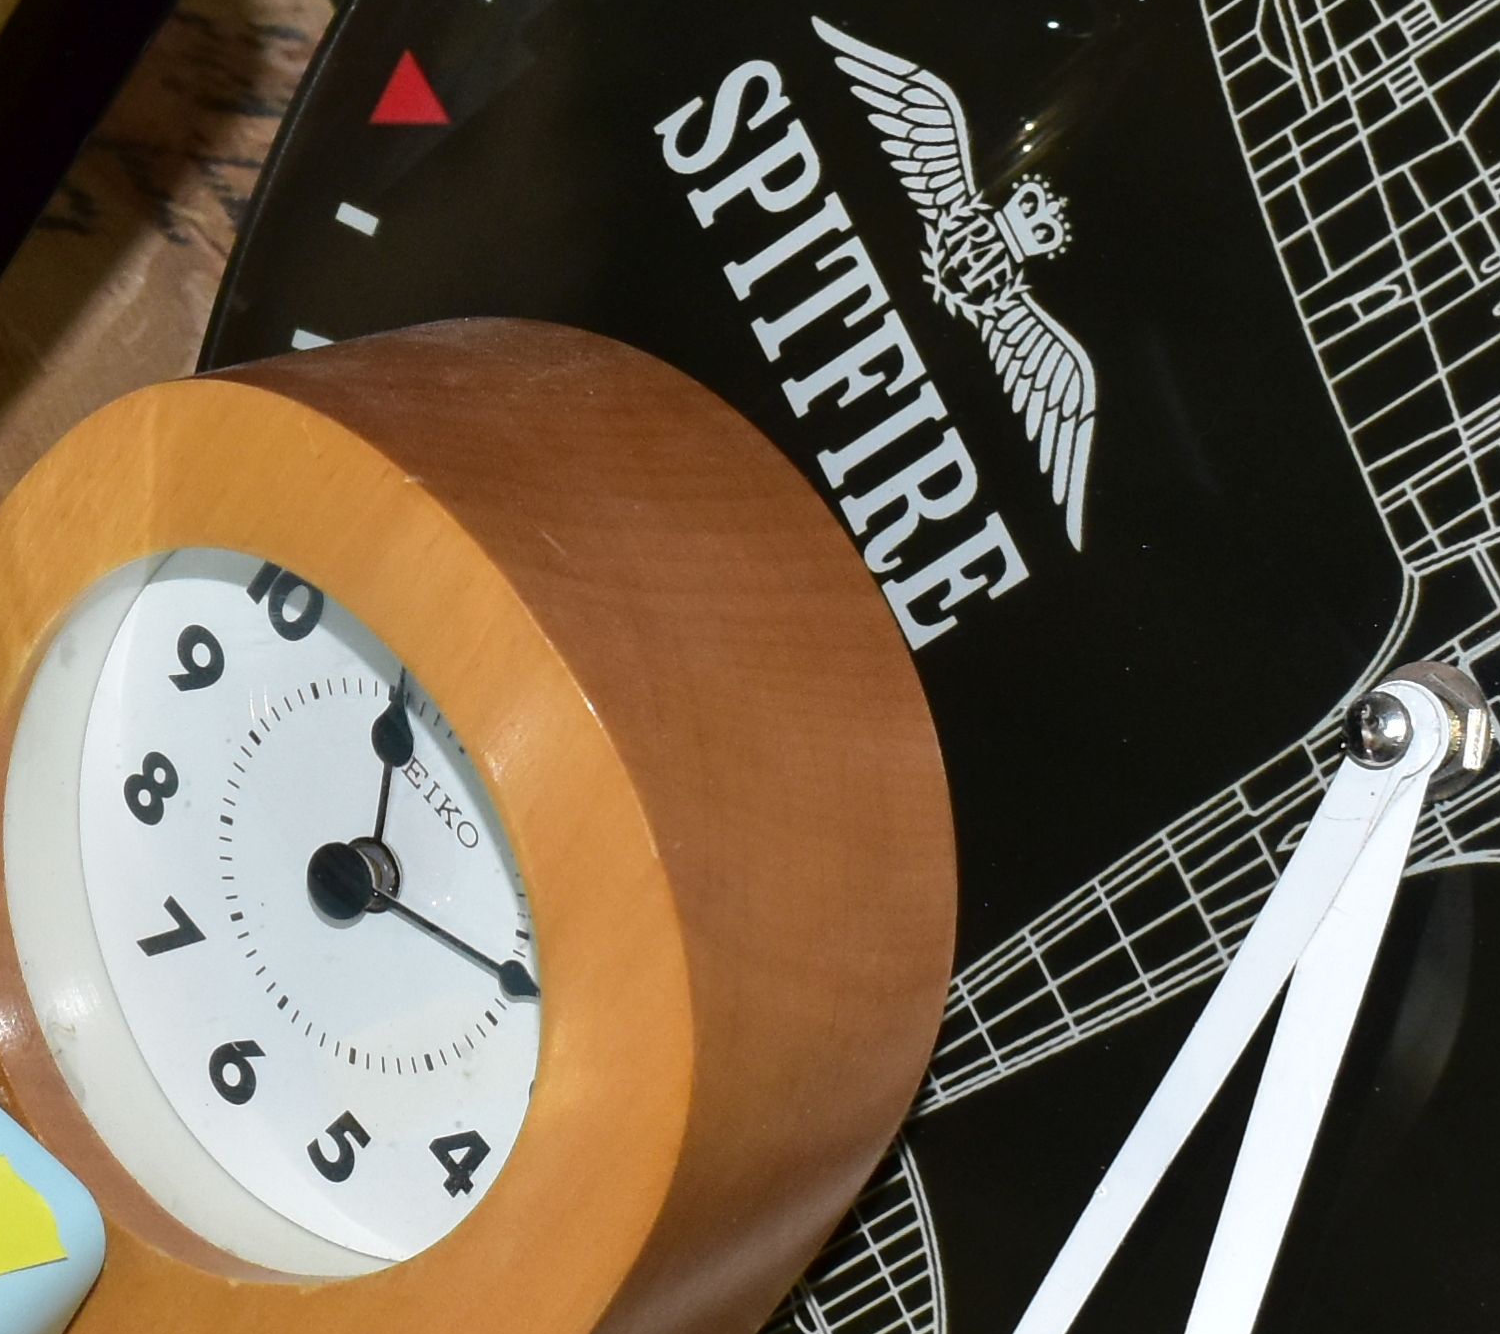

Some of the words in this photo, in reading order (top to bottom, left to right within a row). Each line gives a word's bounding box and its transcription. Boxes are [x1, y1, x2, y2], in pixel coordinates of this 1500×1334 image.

[941, 214, 1013, 293] RAF
[654, 59, 1030, 651] SPITFIRE
[247, 562, 326, 642] 10
[168, 624, 225, 692] 9
[123, 751, 180, 827] 8
[402, 756, 479, 848] EIKO
[137, 896, 208, 957] 7
[209, 1038, 267, 1106] 6
[306, 1110, 372, 1185] 5
[429, 1129, 492, 1199] 4
